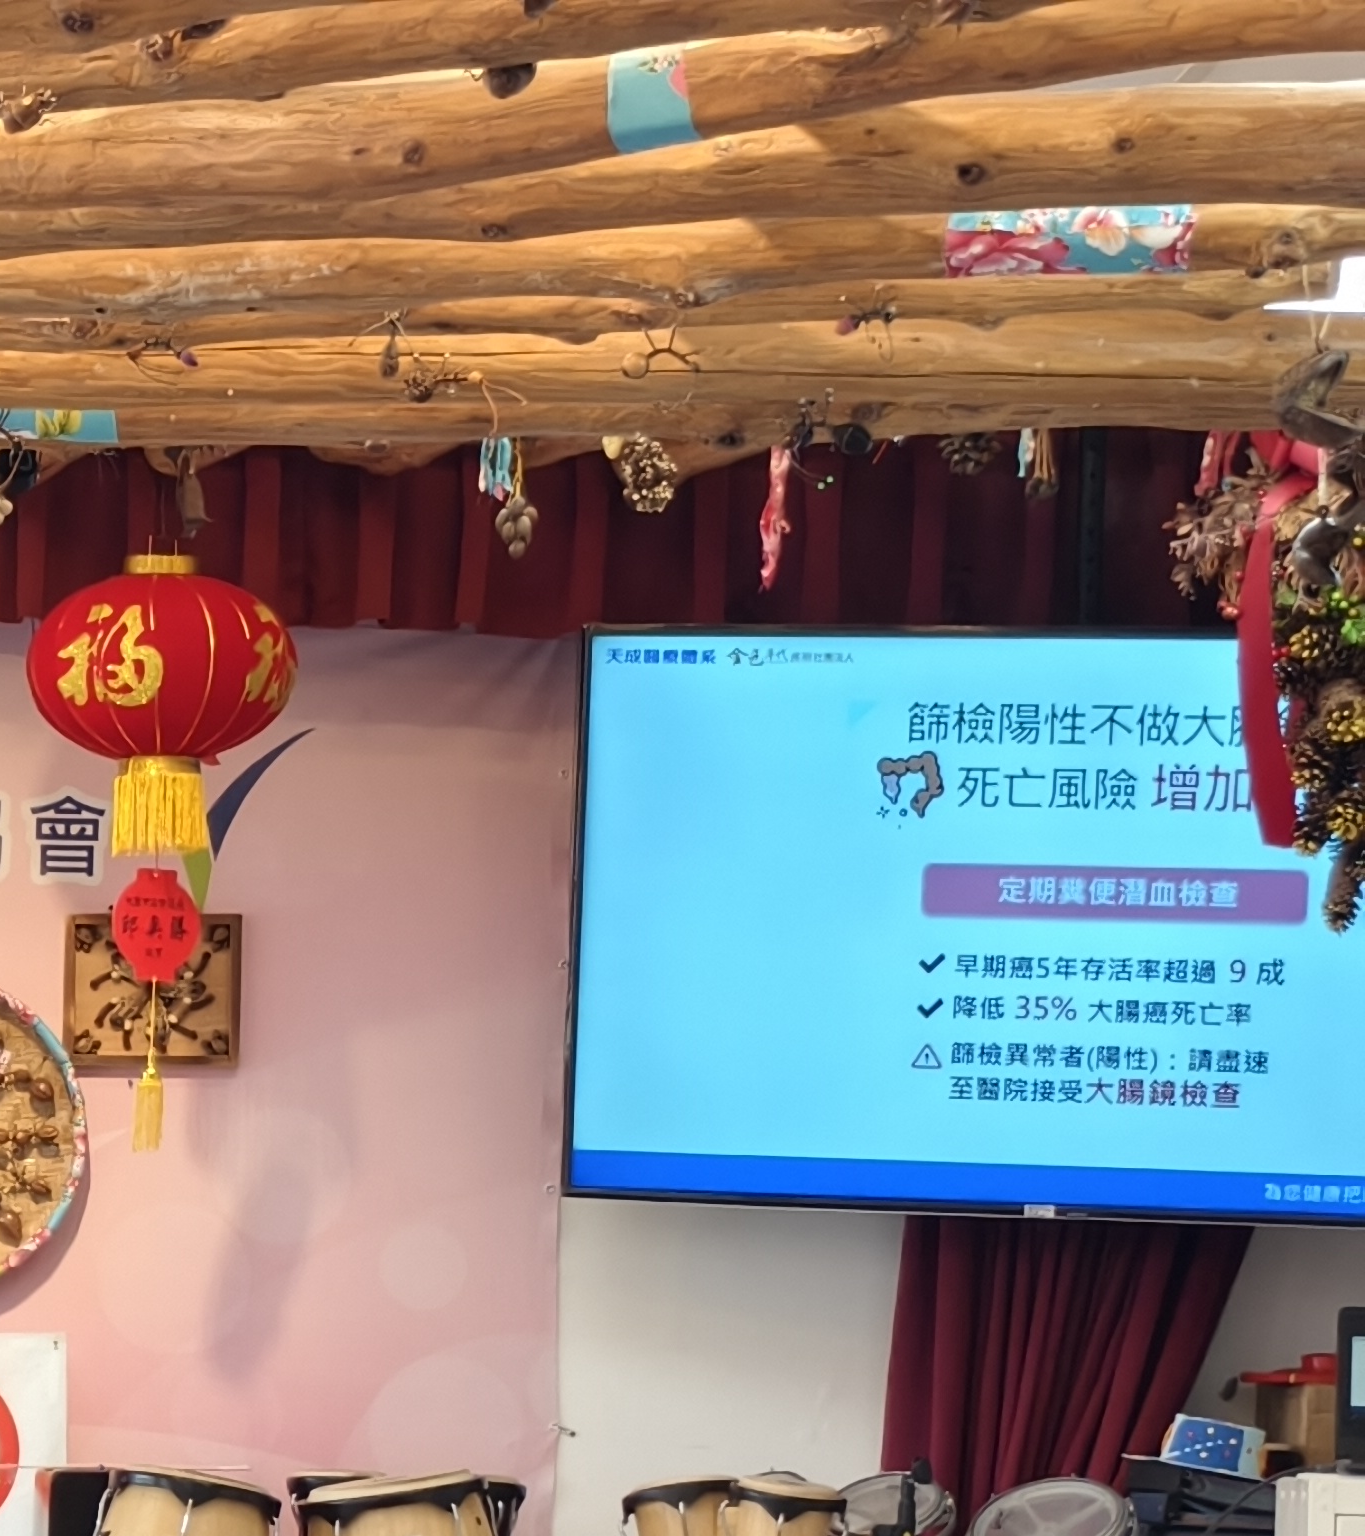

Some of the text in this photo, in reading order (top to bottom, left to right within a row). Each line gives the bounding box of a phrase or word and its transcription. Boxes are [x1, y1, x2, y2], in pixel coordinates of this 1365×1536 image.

[57, 603, 164, 707] 福
[907, 701, 1244, 748] 篩檢陽性不做大
[957, 766, 1138, 811] 死亡風險
[1229, 959, 1247, 983] 9
[1256, 959, 1287, 987] 成
[952, 995, 1252, 1028] 降低 35% 大腸癌死亡率
[948, 1076, 1242, 1109] 至醫院接受大腸鏡檢查
